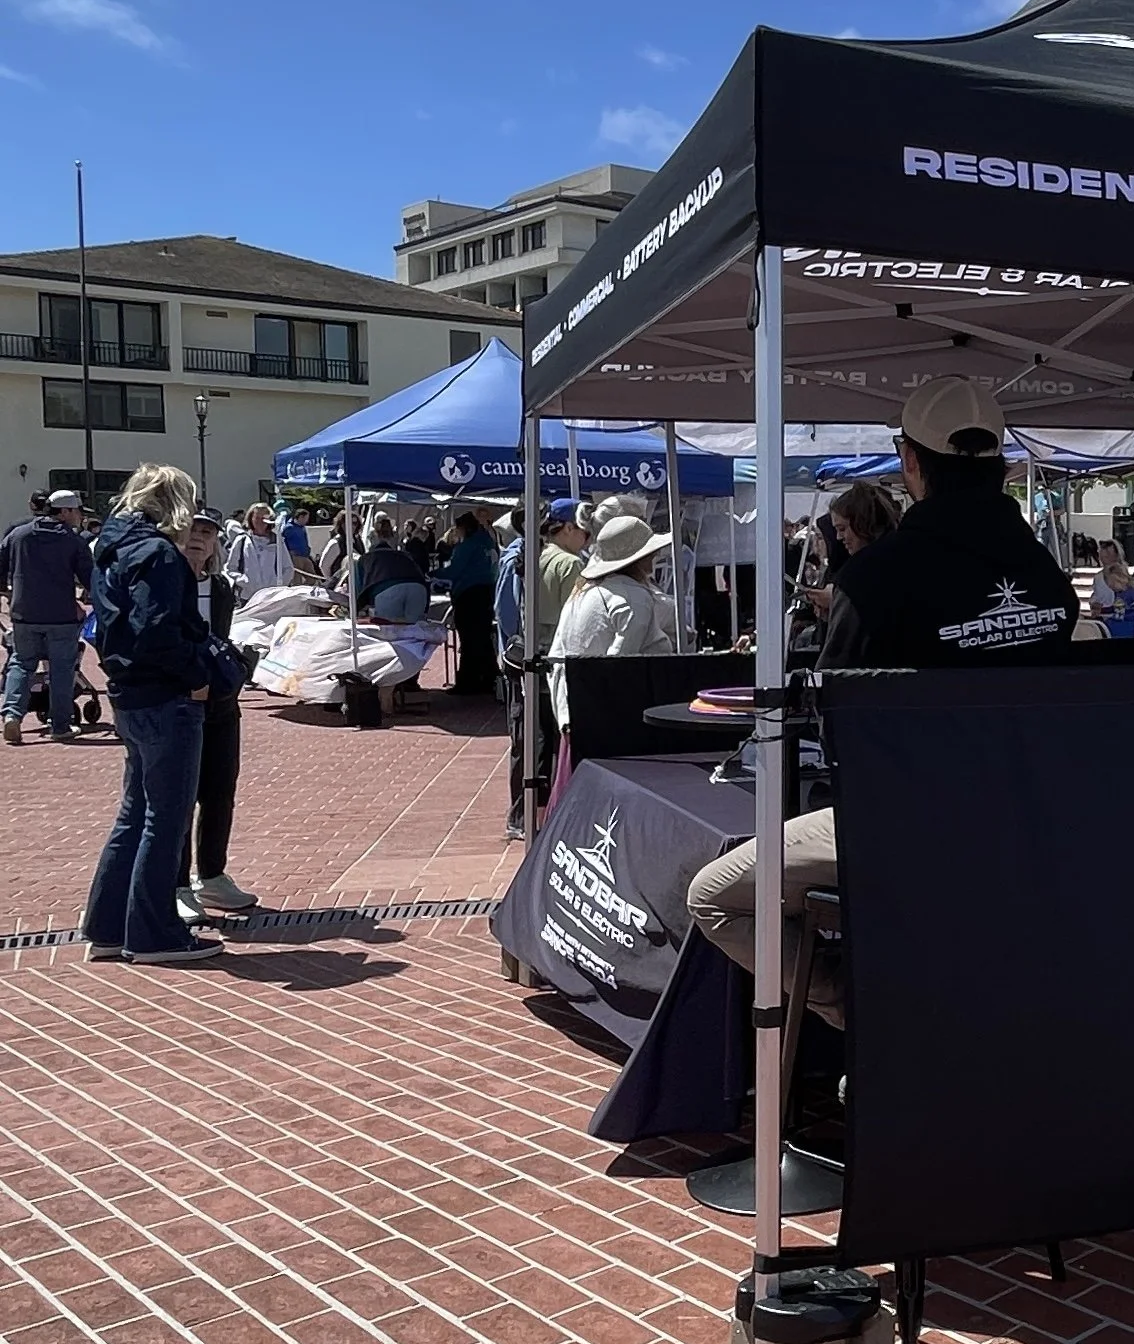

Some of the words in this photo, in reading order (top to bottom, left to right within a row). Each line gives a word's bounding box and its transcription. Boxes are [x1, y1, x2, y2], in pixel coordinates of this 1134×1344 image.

[622, 217, 668, 281] BATTERY
[668, 166, 723, 238] BACKUP
[939, 607, 1067, 640] SANDBAR
[958, 631, 1003, 648] SOLAR
[1015, 624, 1059, 638] ELECTRIC
[549, 871, 575, 904] SOLAR
[580, 901, 635, 949] ELECTRIC
[552, 840, 648, 935] SANDBAR
